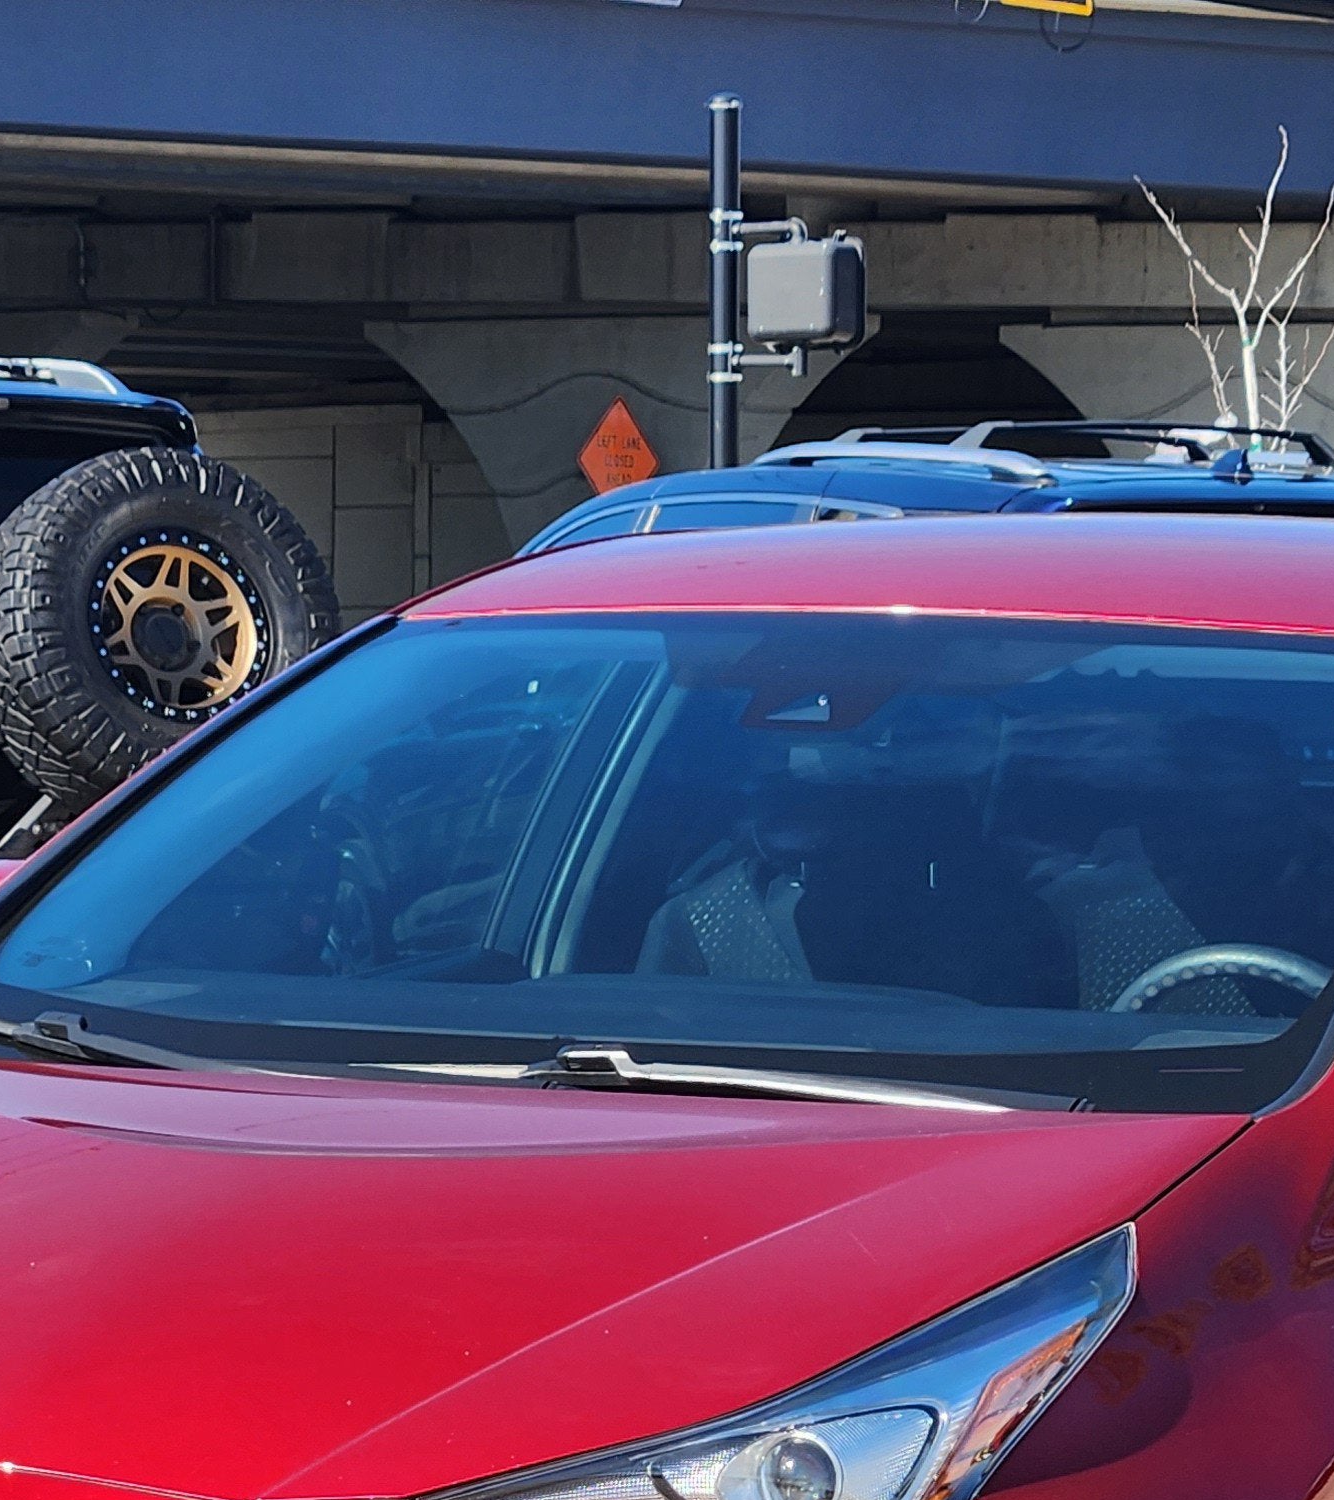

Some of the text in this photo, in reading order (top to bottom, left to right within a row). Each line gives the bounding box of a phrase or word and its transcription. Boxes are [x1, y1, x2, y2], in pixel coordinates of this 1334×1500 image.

[598, 434, 642, 450] LEFT LANE
[605, 454, 635, 468] CLOSED
